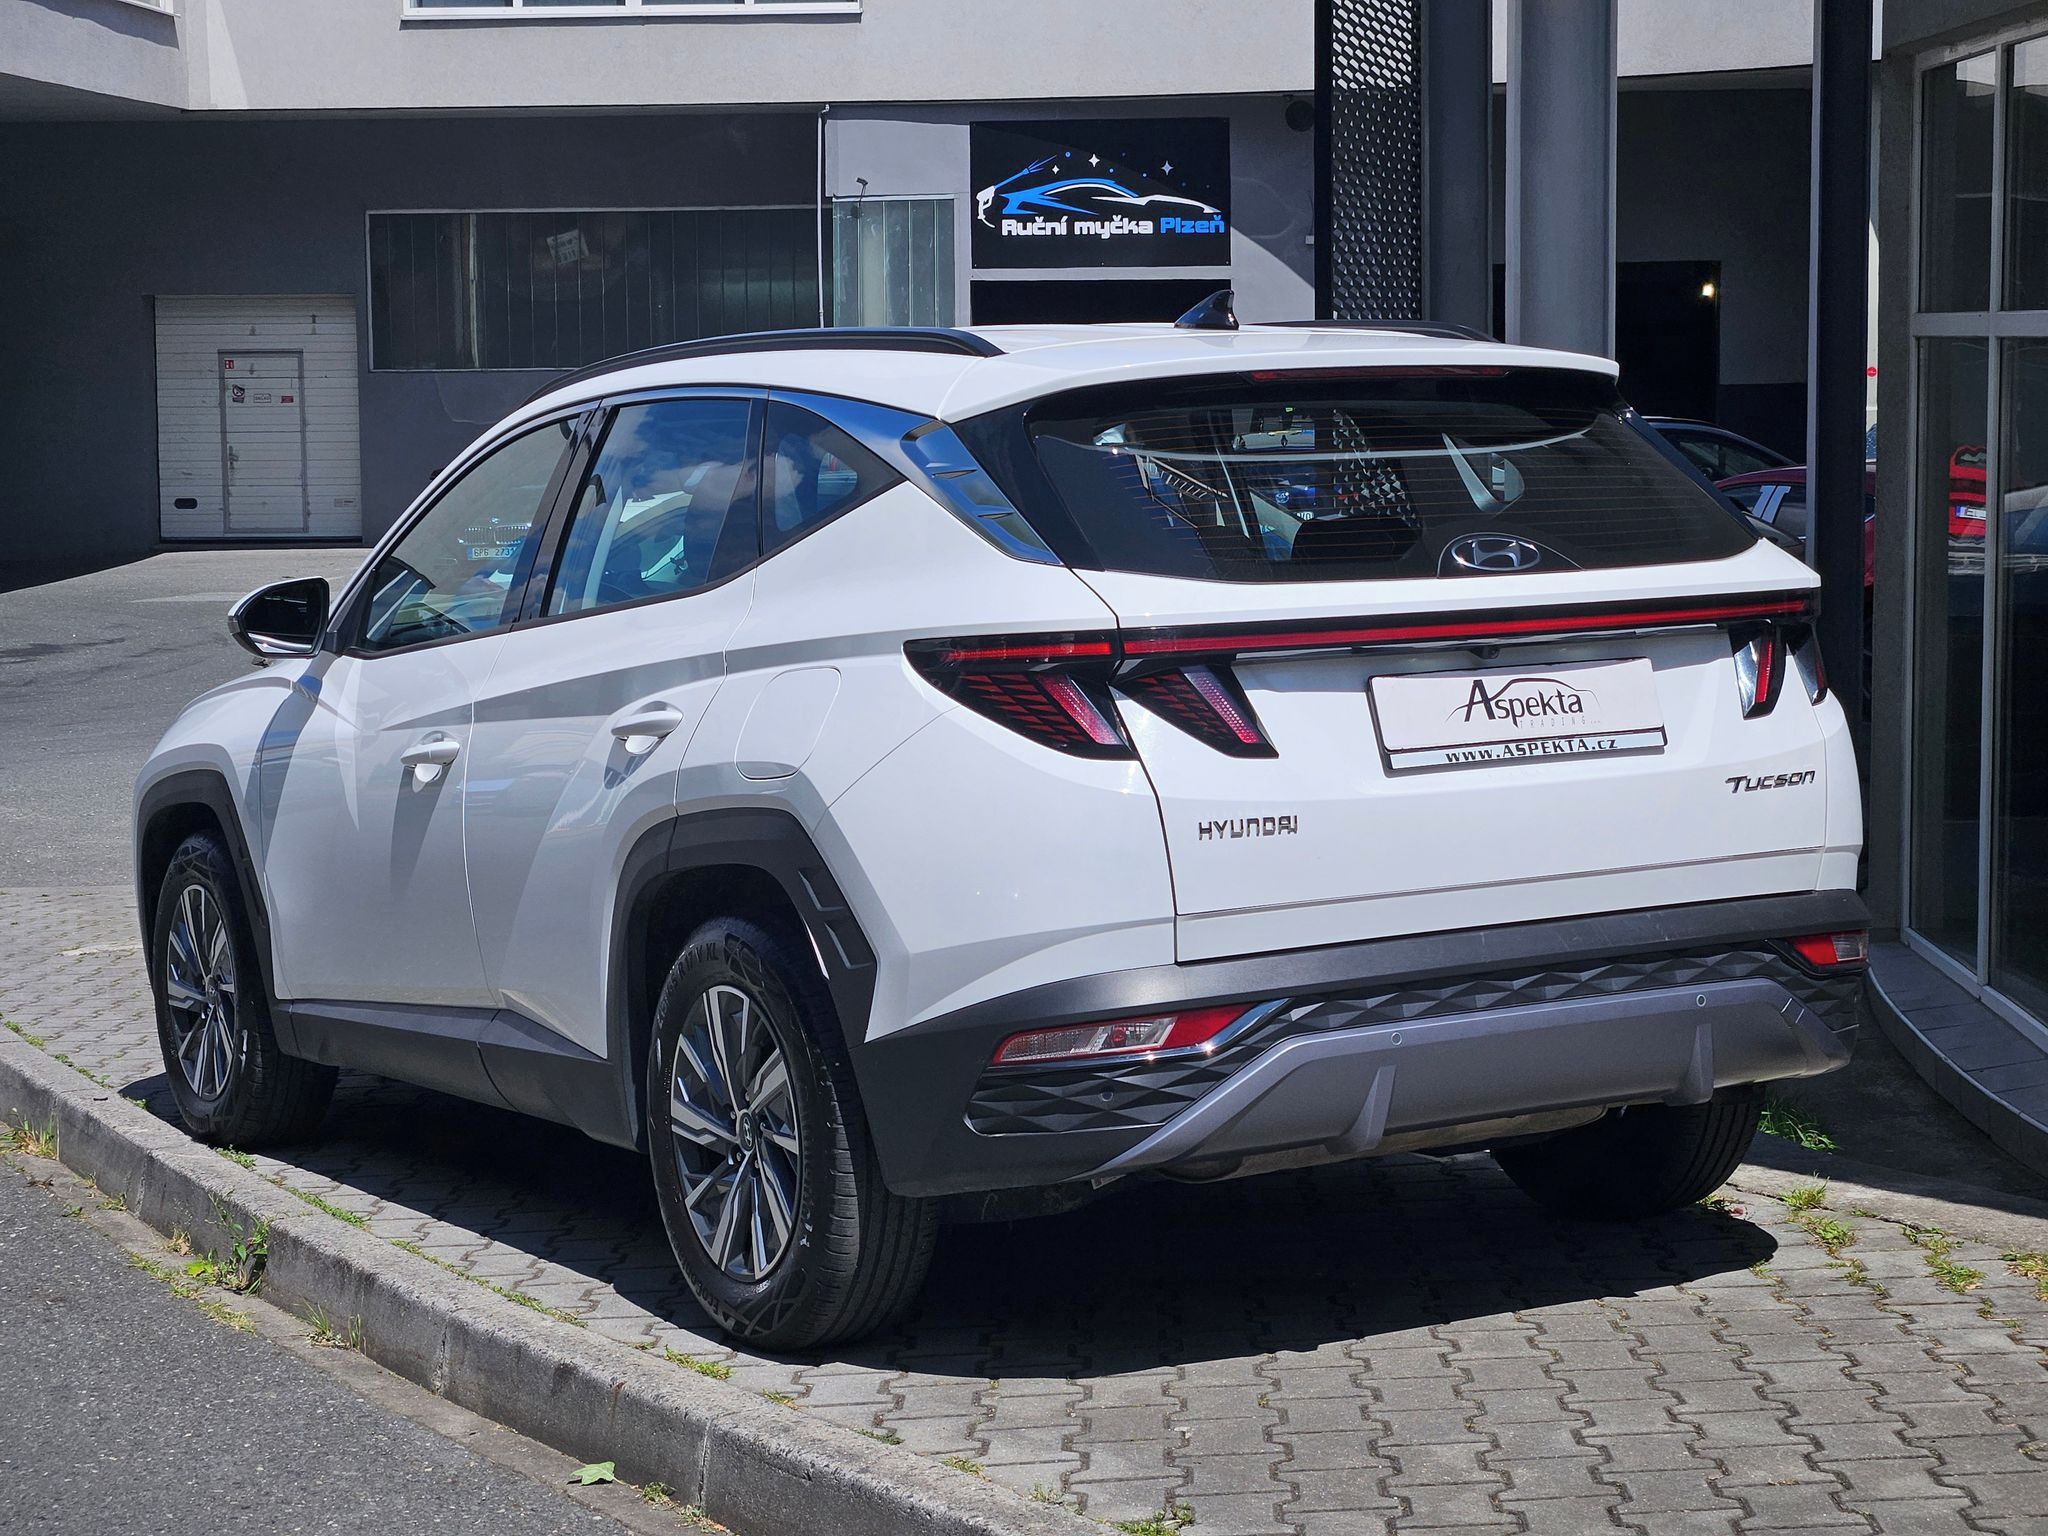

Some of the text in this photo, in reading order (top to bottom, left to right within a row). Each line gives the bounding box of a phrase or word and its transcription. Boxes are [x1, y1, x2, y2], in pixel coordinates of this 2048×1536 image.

[1002, 214, 1225, 239] Ruční myčka Plzeň
[1464, 679, 1584, 728] Aspekta
[1445, 739, 1618, 763] www.ASPEKTA.cz
[1198, 815, 1298, 841] HYUNDAI
